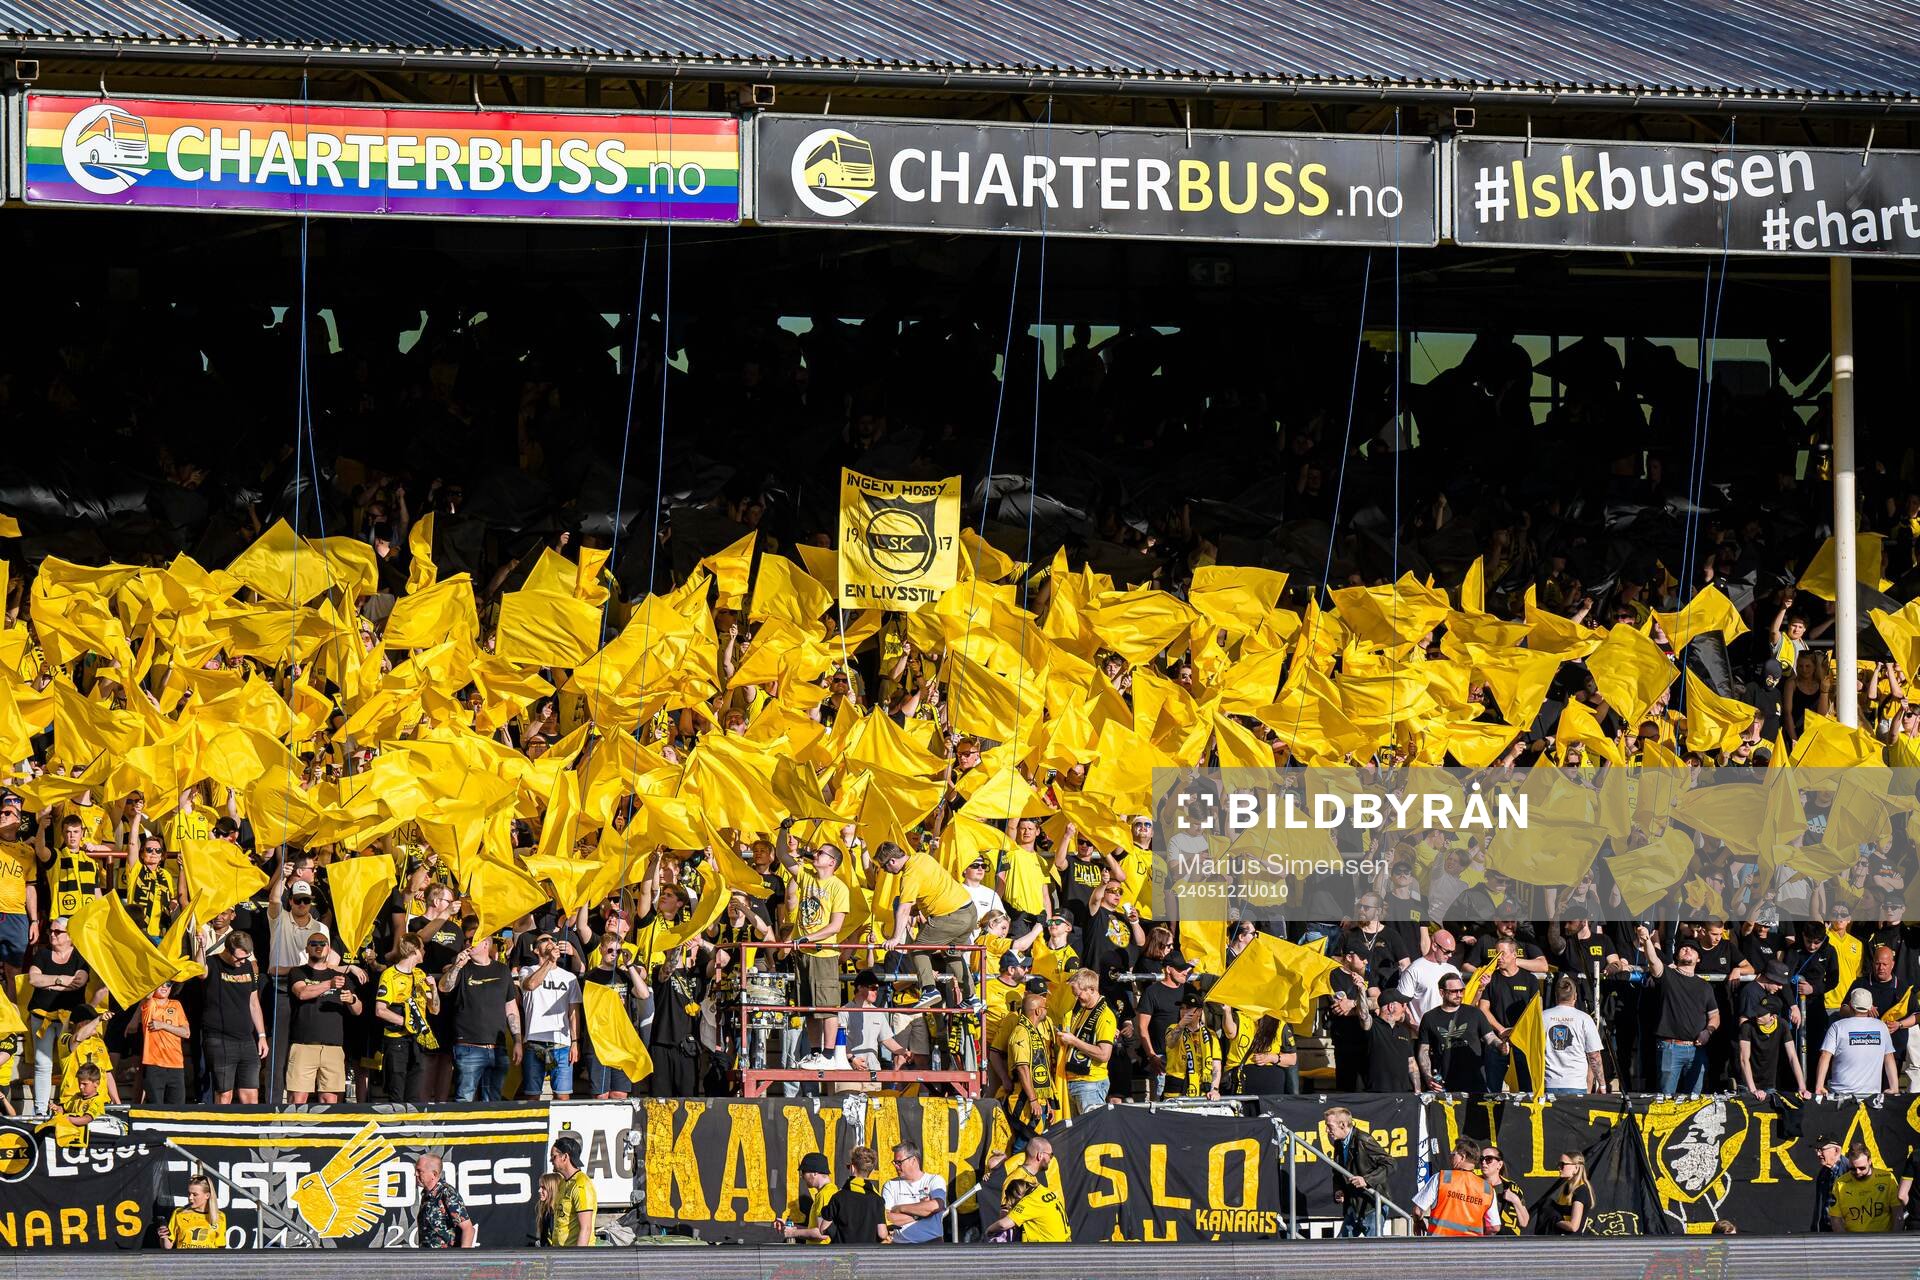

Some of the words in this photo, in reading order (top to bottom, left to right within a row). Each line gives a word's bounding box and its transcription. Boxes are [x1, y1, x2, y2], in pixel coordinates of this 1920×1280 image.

[166, 124, 706, 196] CHARTERBUSS.no
[889, 147, 1404, 219] CHARTERBUSS.no
[846, 473, 895, 494] INGEN
[846, 527, 859, 543] 19
[875, 536, 913, 550] LSK
[938, 536, 953, 551] 17
[845, 583, 866, 598] EN
[0, 1148, 28, 1159] SK
[1447, 1190, 1484, 1206] SONELEDER
[1849, 1198, 1884, 1225] DNB
